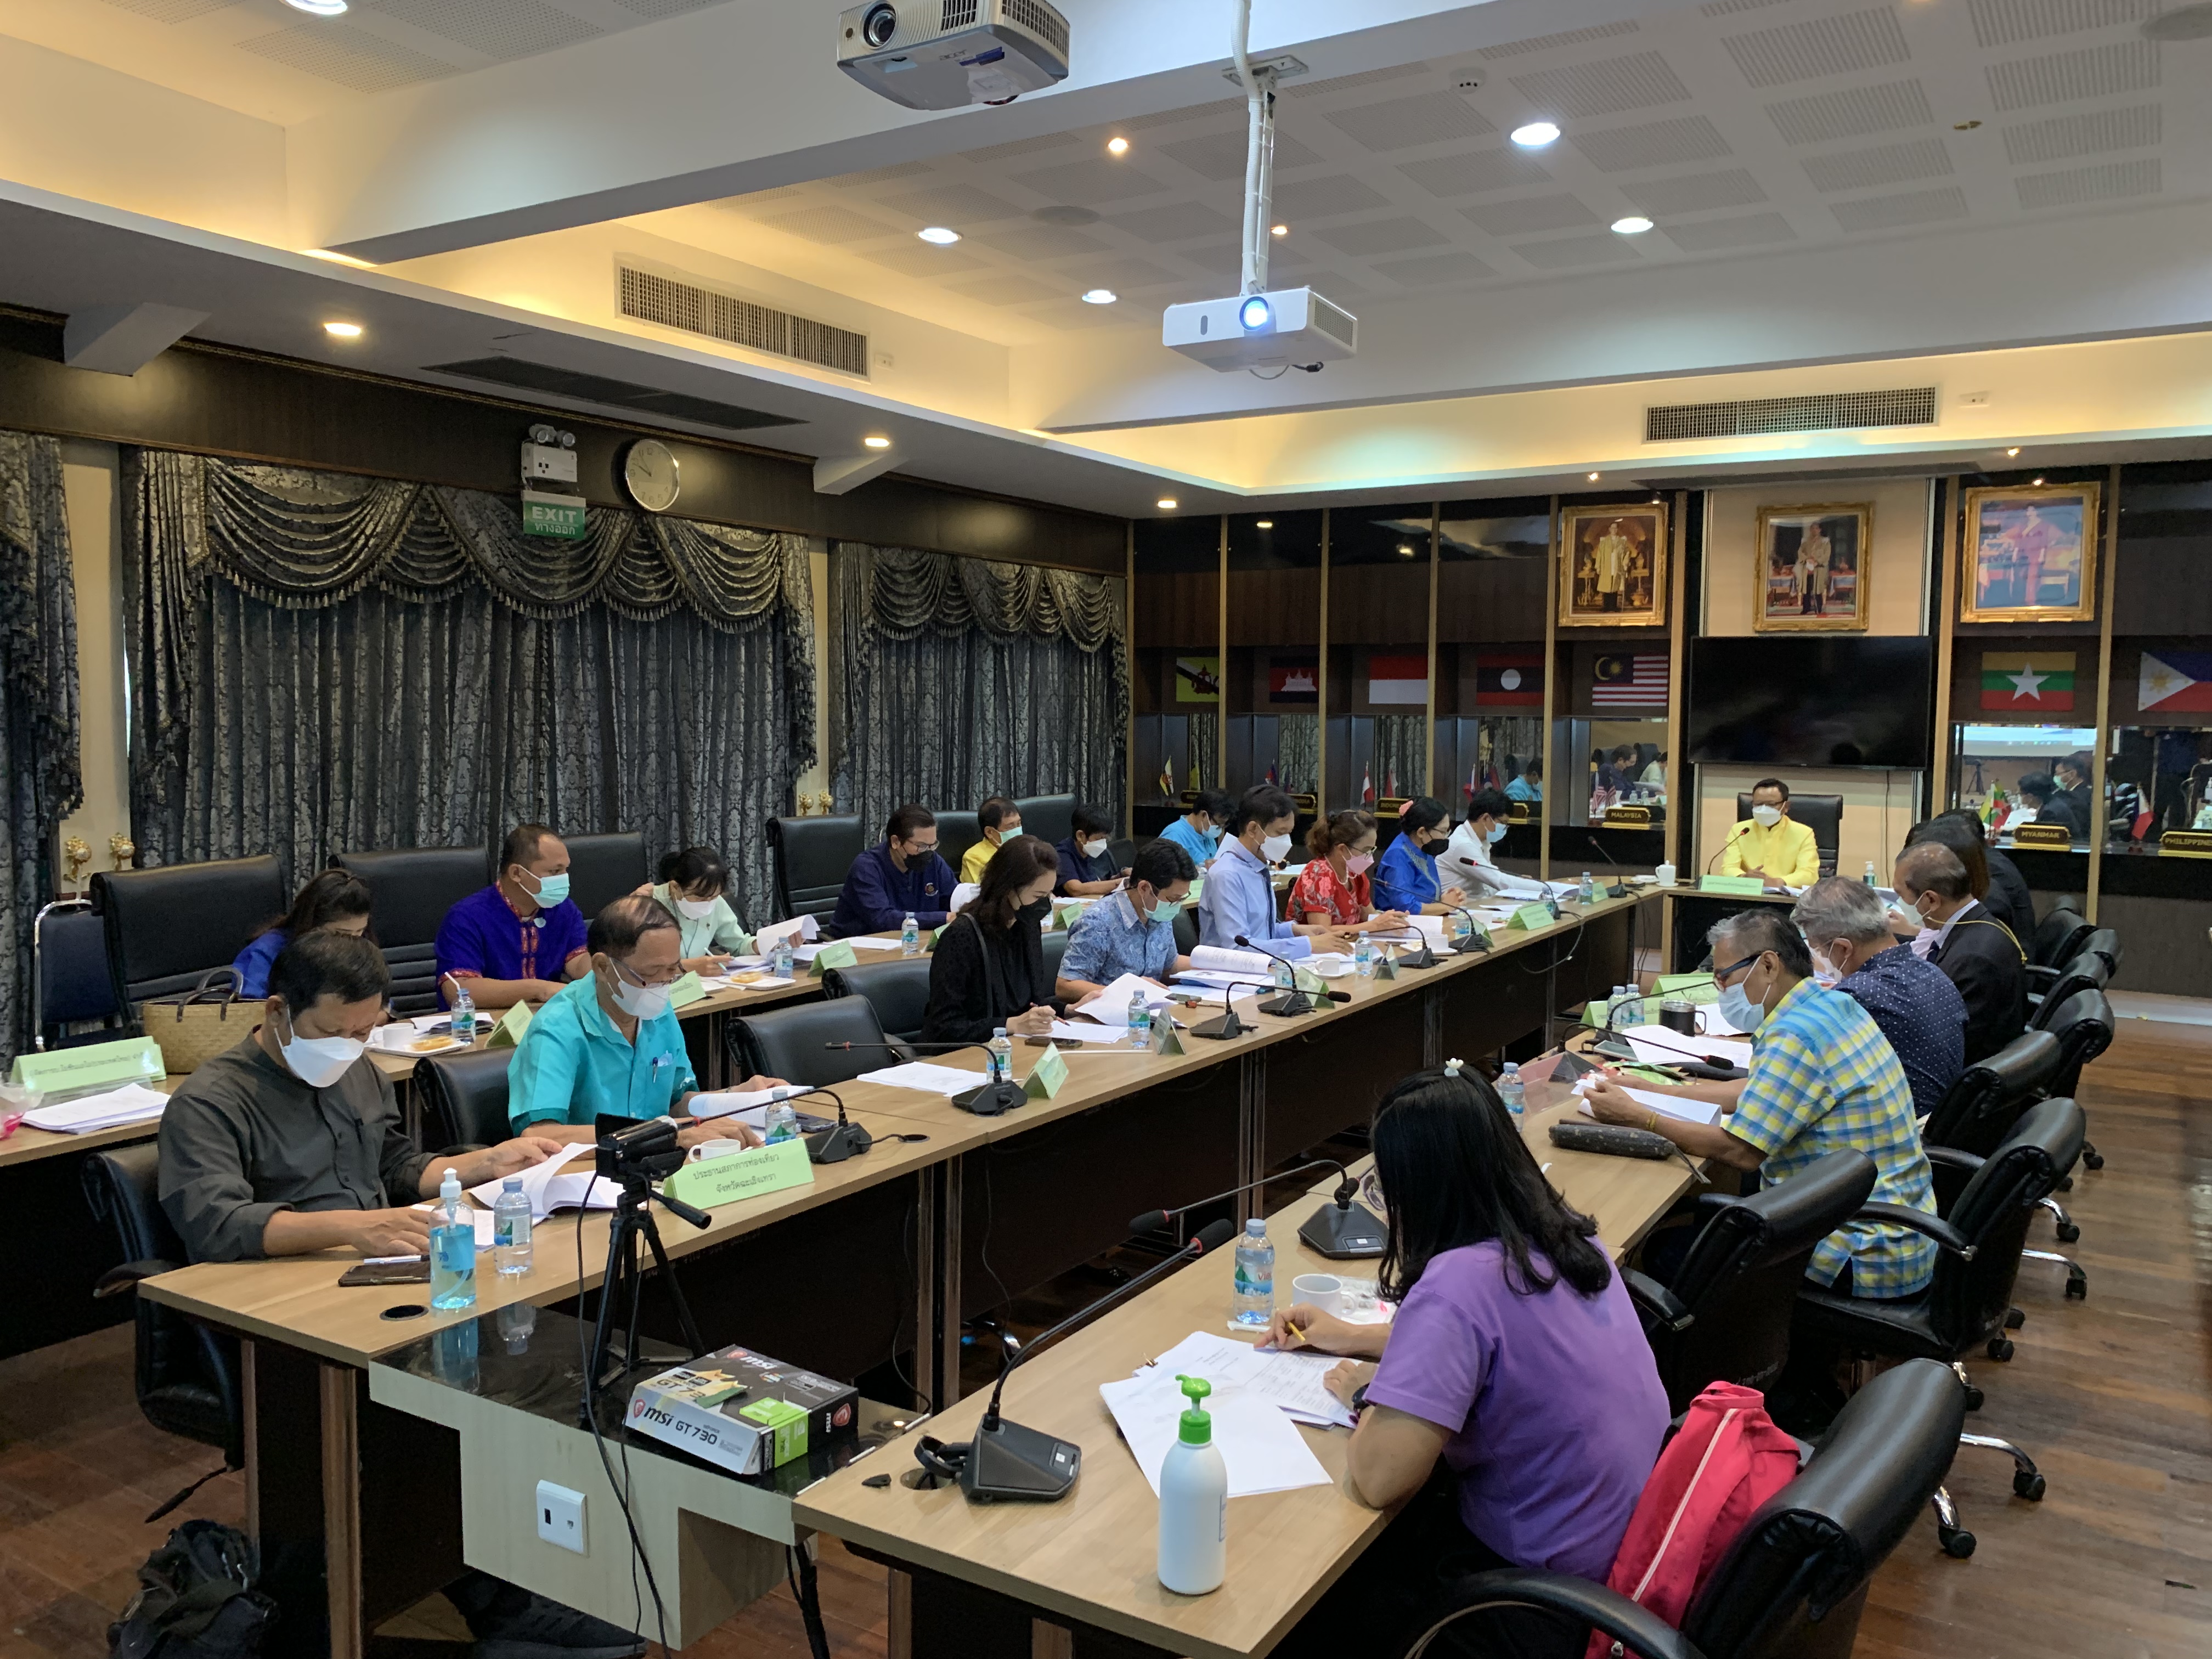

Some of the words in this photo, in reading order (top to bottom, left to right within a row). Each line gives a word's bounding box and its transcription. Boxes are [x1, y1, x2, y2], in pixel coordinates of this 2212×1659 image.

[939, 49, 967, 60] acer
[532, 506, 577, 523] EXIT
[534, 522, 575, 535] ทางออก
[2165, 838, 2212, 846] PHILIPPINE
[740, 1356, 777, 1369] msi
[657, 1379, 682, 1389] GT
[679, 1387, 706, 1397] 73
[644, 1407, 674, 1426] msi
[675, 1420, 692, 1435] GT
[691, 1427, 718, 1445] 730
